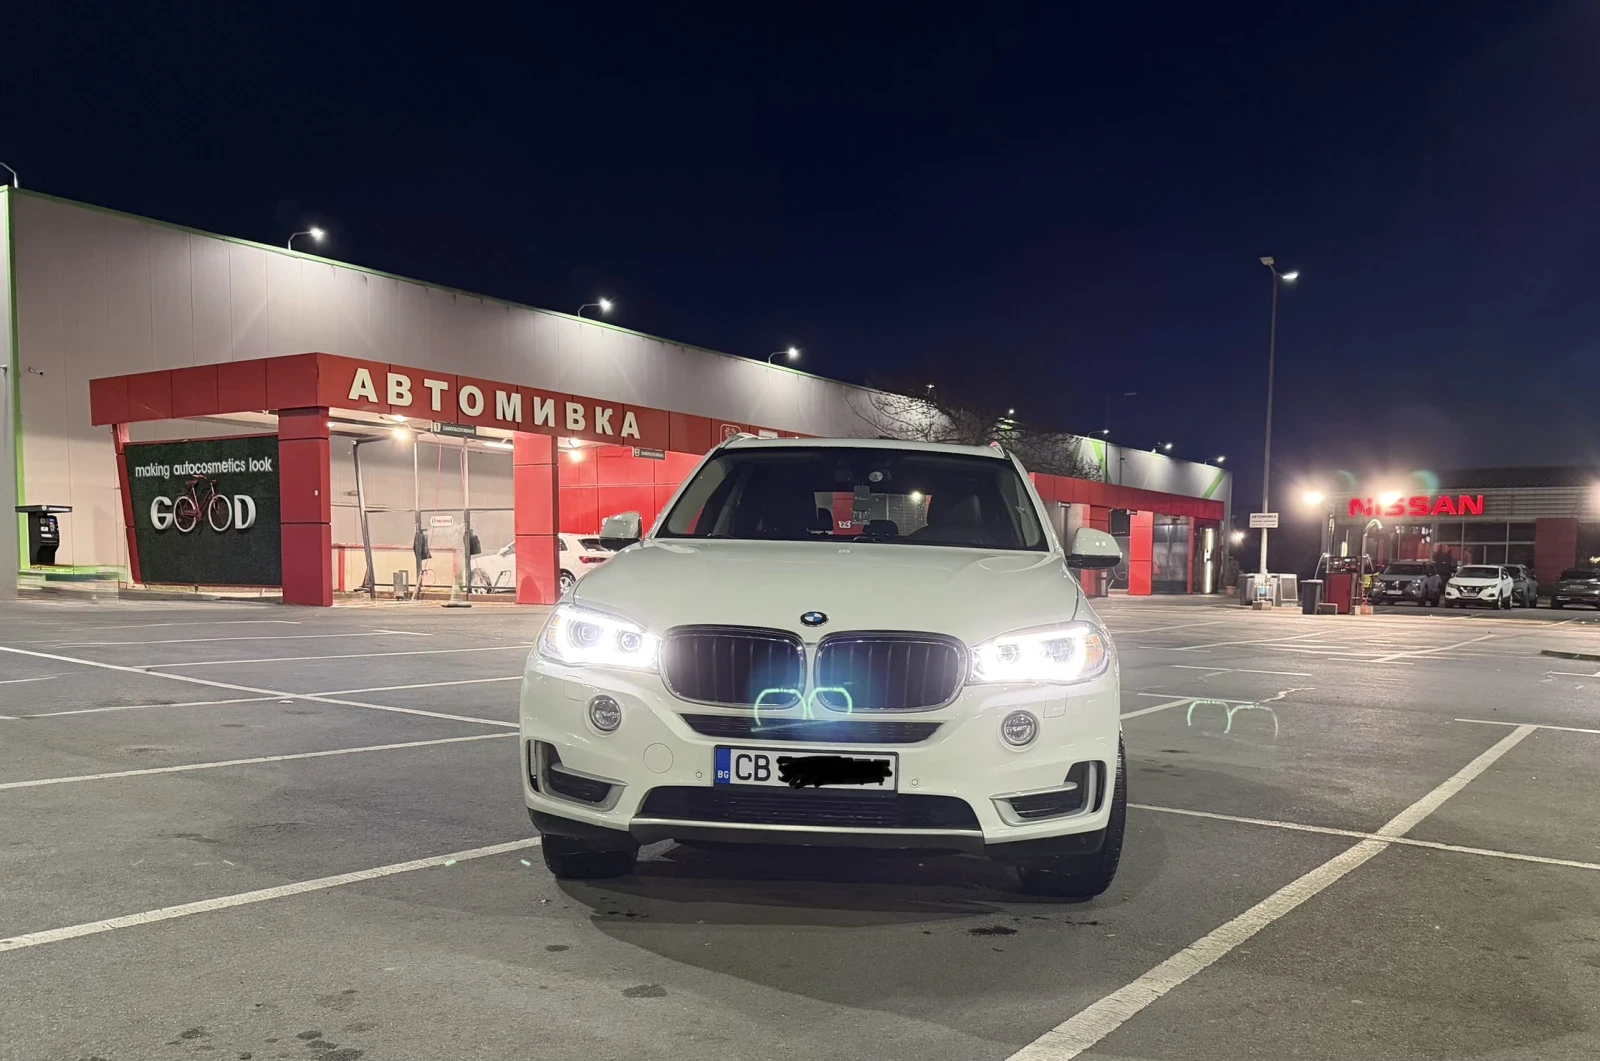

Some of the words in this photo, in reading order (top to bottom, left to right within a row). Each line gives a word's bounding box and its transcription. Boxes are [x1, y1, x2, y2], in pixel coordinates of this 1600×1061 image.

[348, 367, 641, 440] АВТОМИВКА
[135, 463, 170, 479] making
[173, 458, 246, 476] autocosmetics
[249, 457, 273, 472] look
[1348, 494, 1485, 517] NISSAN
[717, 770, 730, 779] BG
[735, 753, 772, 782] CB
